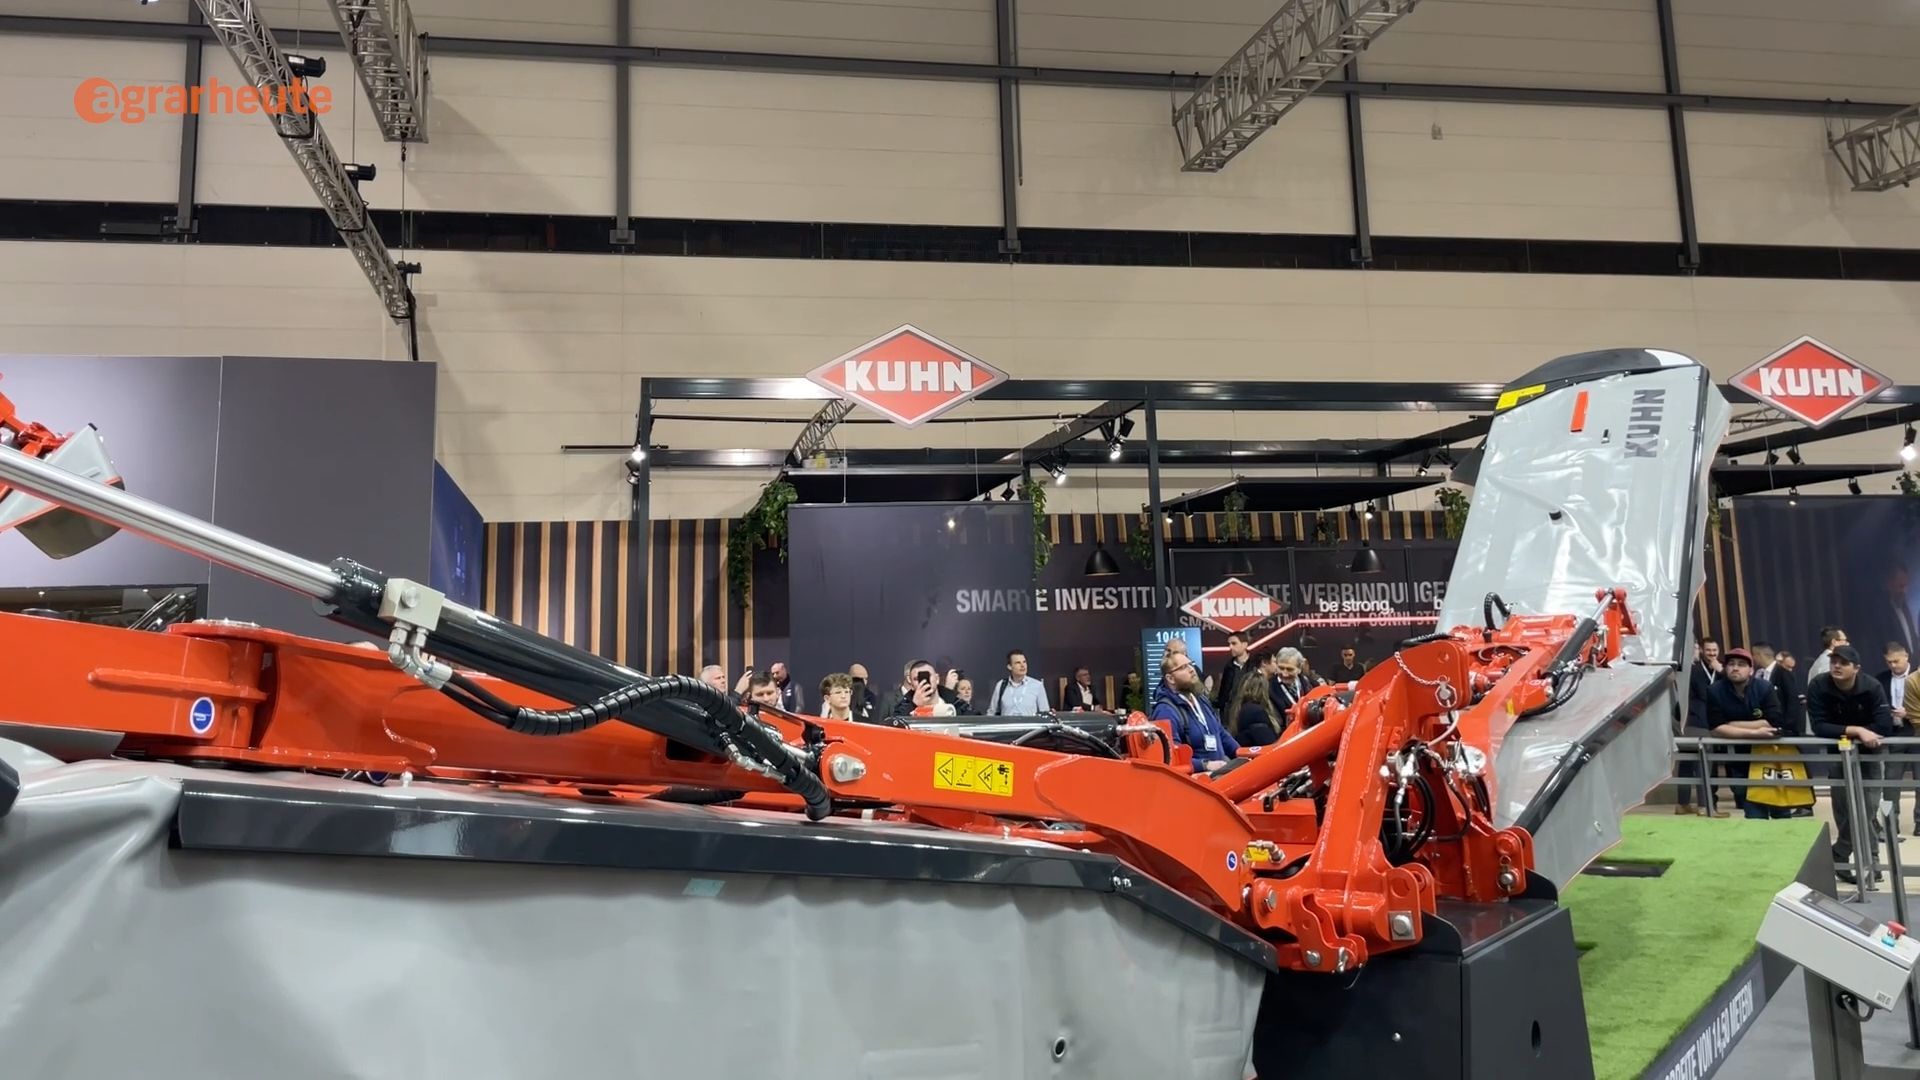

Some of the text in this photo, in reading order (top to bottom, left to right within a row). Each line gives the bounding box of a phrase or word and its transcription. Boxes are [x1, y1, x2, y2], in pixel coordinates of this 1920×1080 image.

[844, 360, 973, 392] KUHN
[1758, 367, 1864, 396] KUHN
[1624, 388, 1667, 459] KUHN
[1201, 597, 1271, 617] KUHN
[1320, 599, 1338, 612] be
[1342, 599, 1394, 615] strong,
